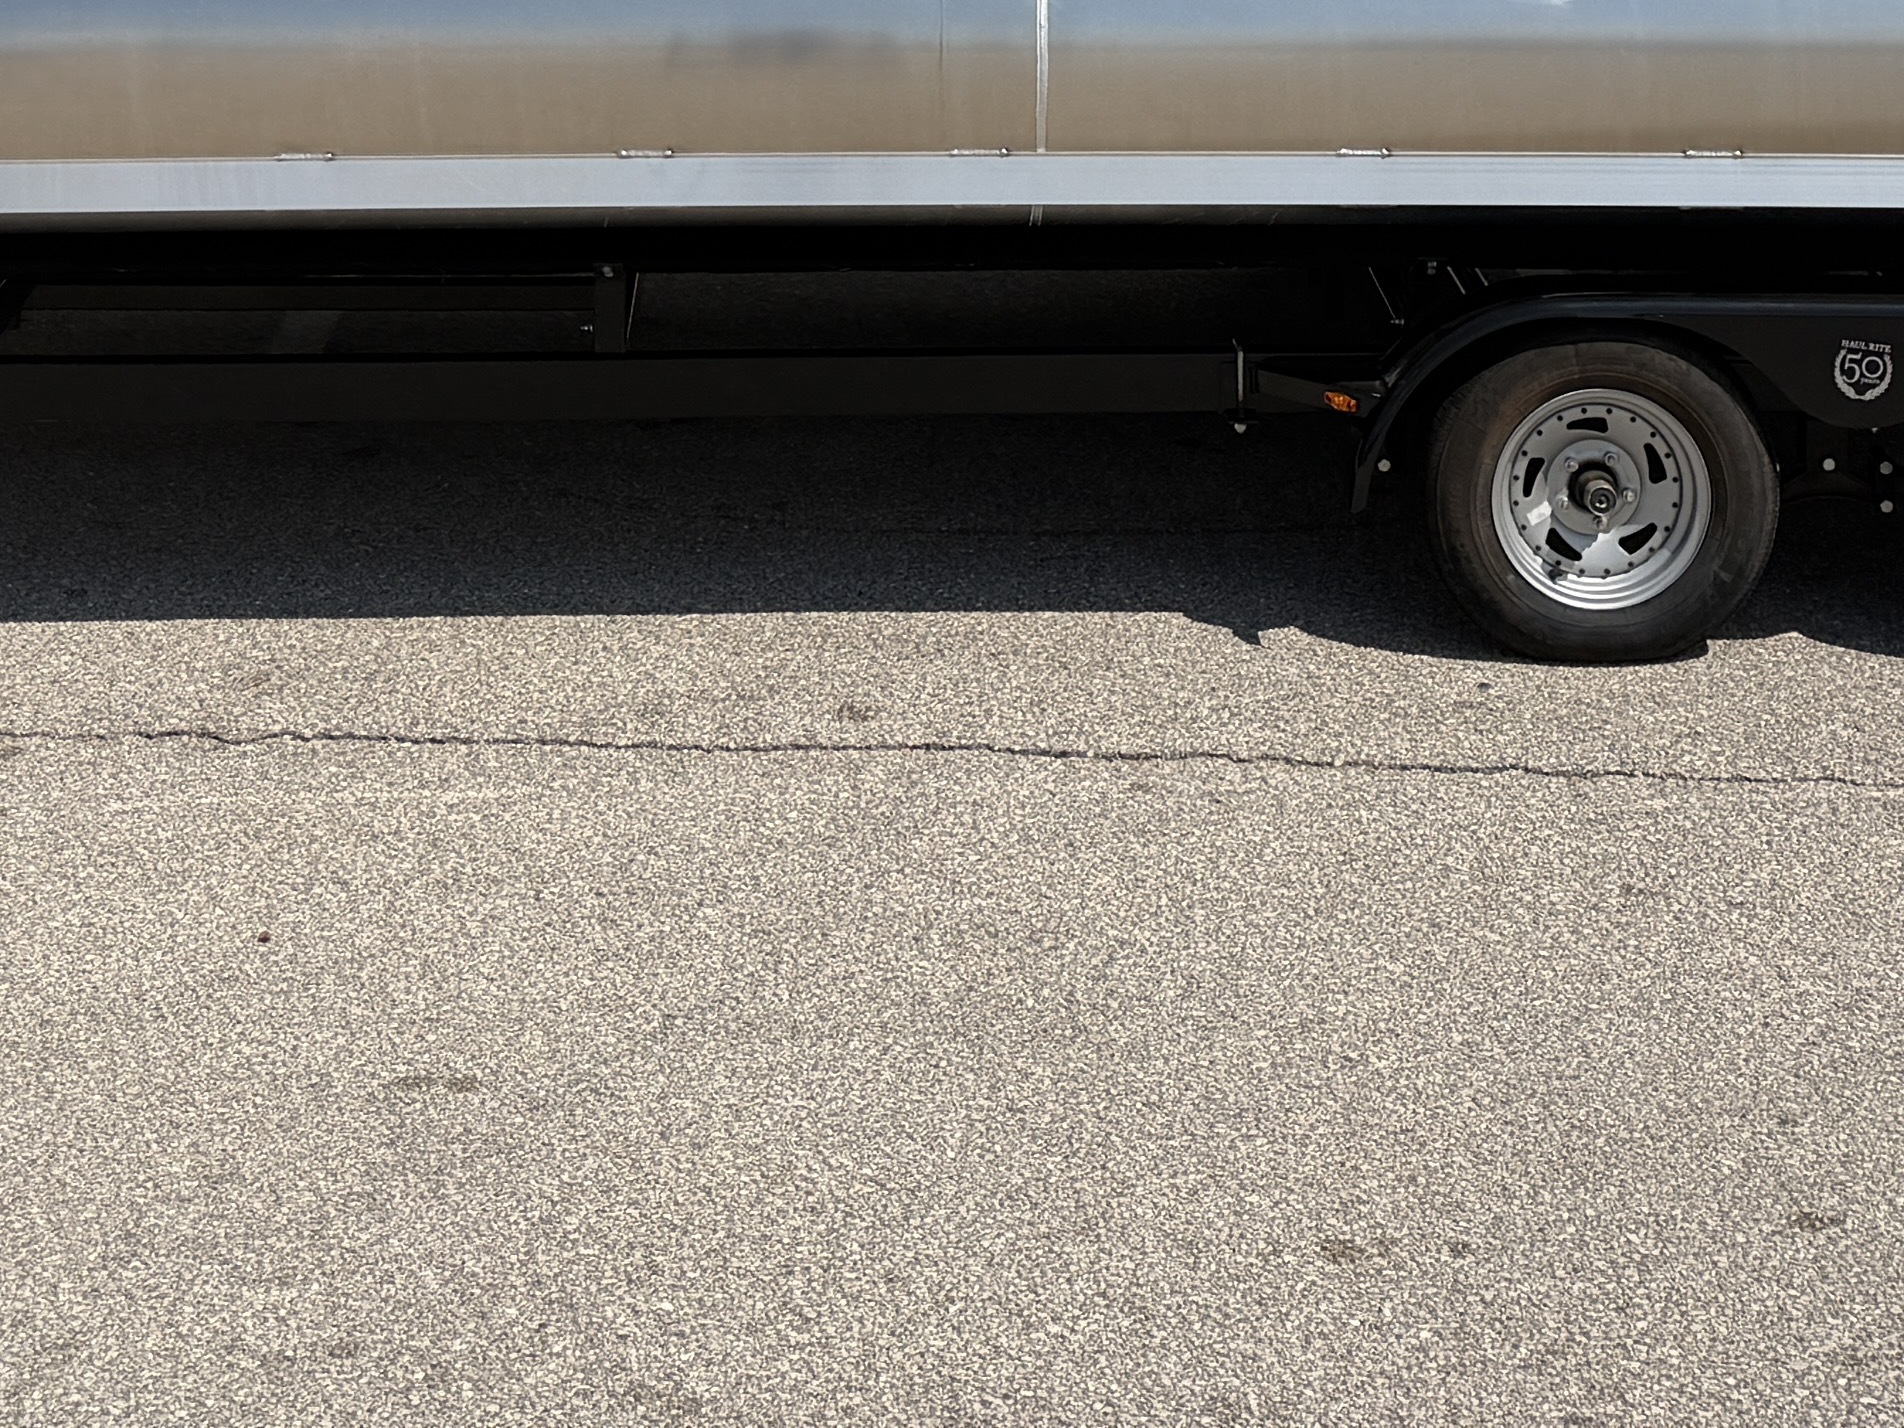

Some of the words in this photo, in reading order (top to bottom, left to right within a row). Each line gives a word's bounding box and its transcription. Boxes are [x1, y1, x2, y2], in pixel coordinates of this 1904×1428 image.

[1841, 339, 1868, 350] HAUL
[1868, 342, 1892, 353] RITE
[1842, 351, 1884, 383] 50
